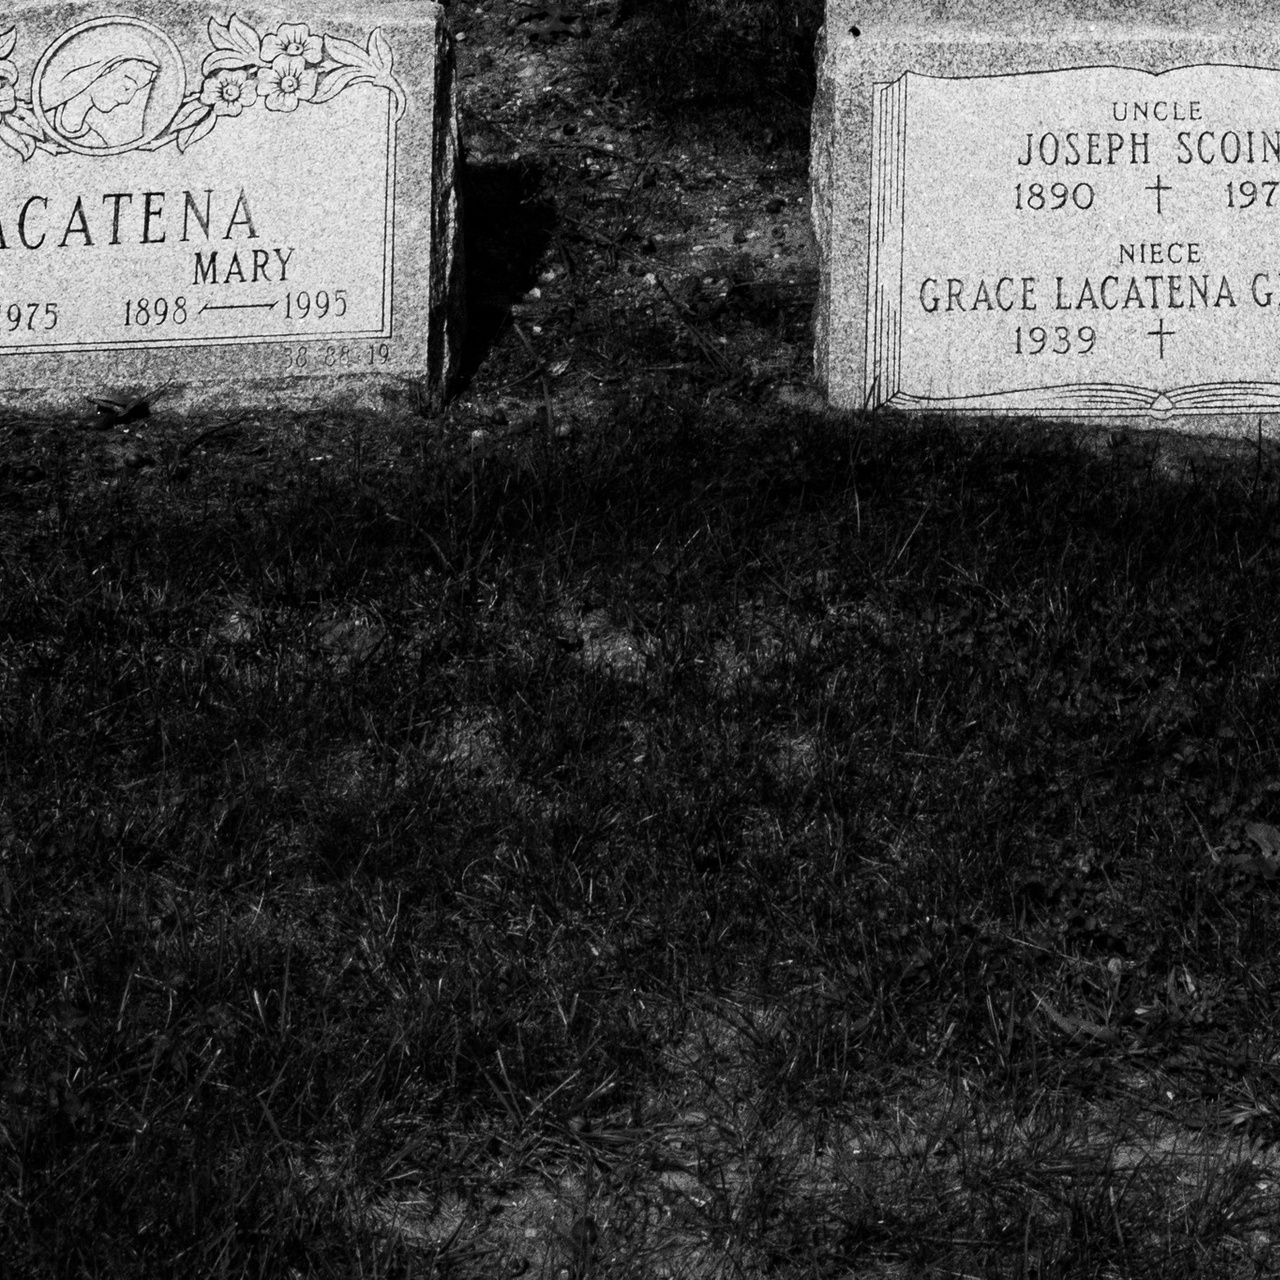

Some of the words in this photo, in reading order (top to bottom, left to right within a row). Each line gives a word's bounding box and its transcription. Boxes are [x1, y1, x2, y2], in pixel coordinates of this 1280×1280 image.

[1112, 100, 1203, 123] UNCLE
[1018, 131, 1151, 166] JOSEPH
[1014, 181, 1096, 211] 1890
[192, 246, 295, 286] MARY
[1119, 242, 1202, 265] NIECE
[123, 295, 189, 327] 1898
[283, 289, 348, 321] 1995
[919, 276, 1037, 314] GRACE
[1055, 272, 1237, 312] LACATENA
[0, 302, 59, 332] 975
[1014, 326, 1097, 355] 1939
